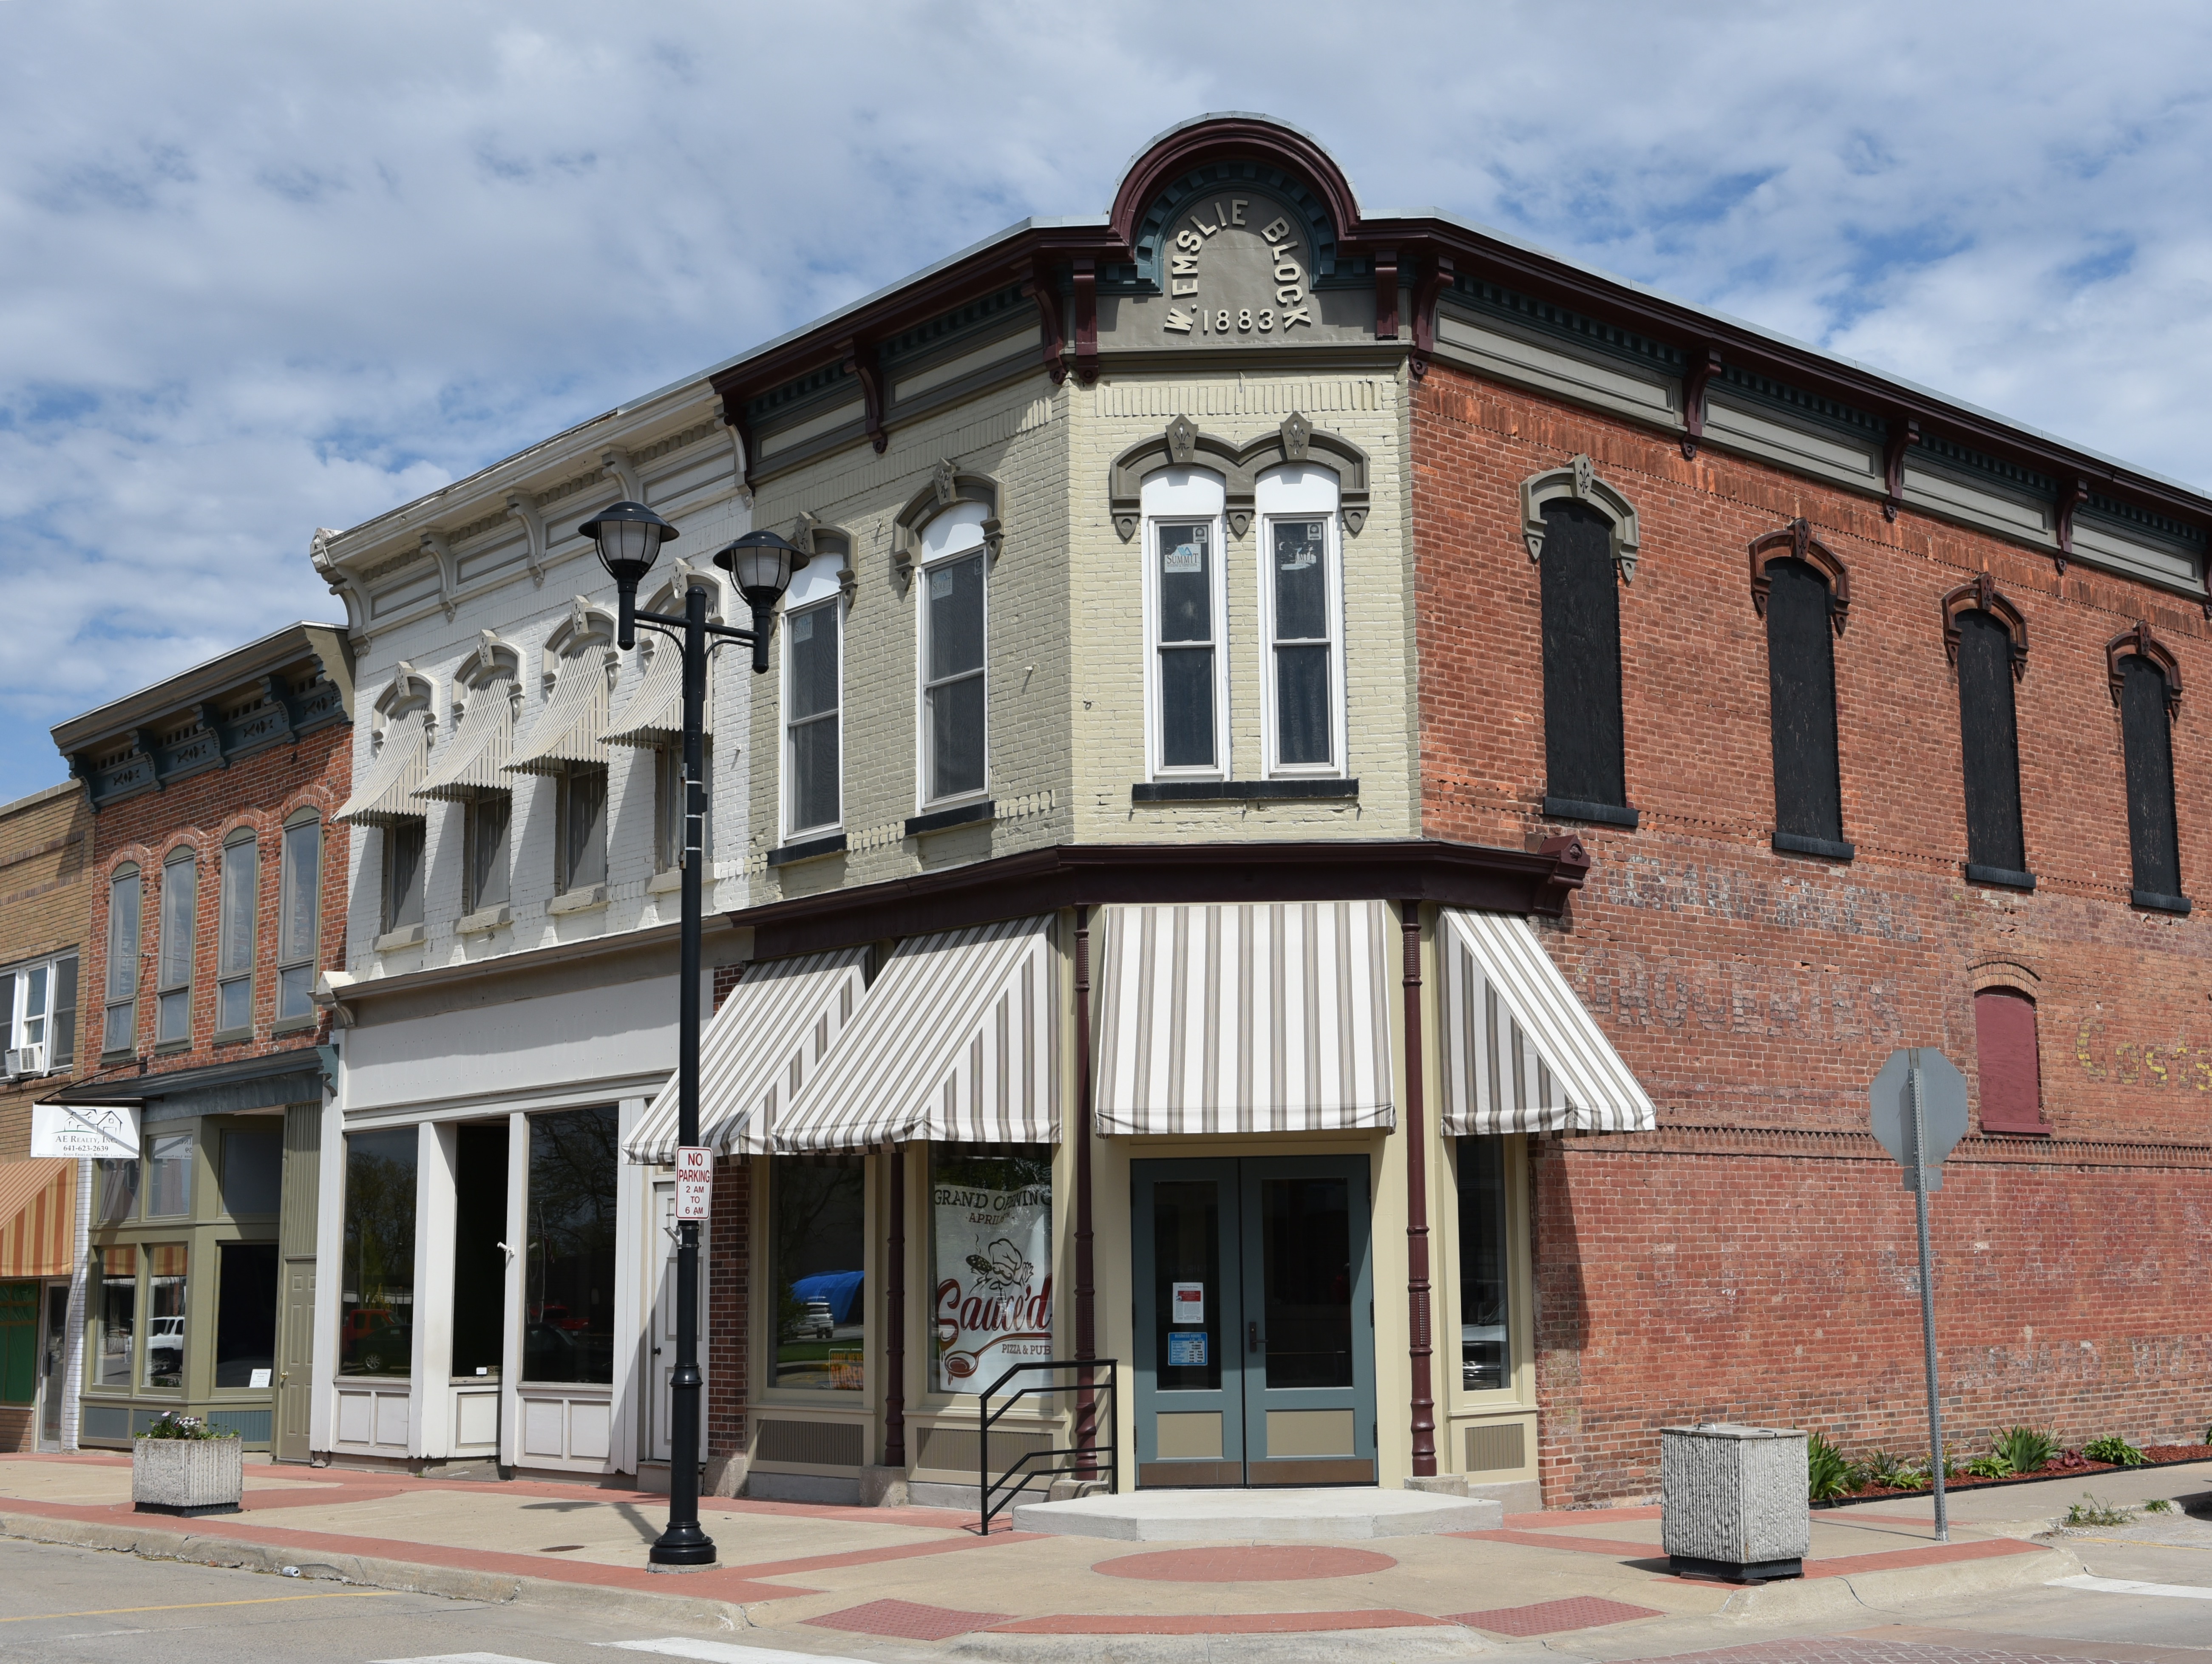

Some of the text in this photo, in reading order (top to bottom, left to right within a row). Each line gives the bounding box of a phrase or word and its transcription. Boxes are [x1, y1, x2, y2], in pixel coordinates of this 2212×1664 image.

[1164, 199, 1312, 332] W. EMSLIE BLOCK
[1203, 309, 1274, 331] 1883
[1166, 553, 1199, 564] SUMMIT
[71, 1136, 99, 1144] REALTY,
[688, 1153, 703, 1166] NO
[679, 1169, 710, 1183] PARKING
[934, 1188, 1052, 1211] GRAND OPENING
[685, 1206, 690, 1214] 6
[938, 1273, 1052, 1352] Sauce'd
[1001, 1344, 1052, 1355] PIZZA & PUB
[830, 1353, 863, 1363] SORRY WE'RE
[831, 1365, 863, 1389] CLOSED
